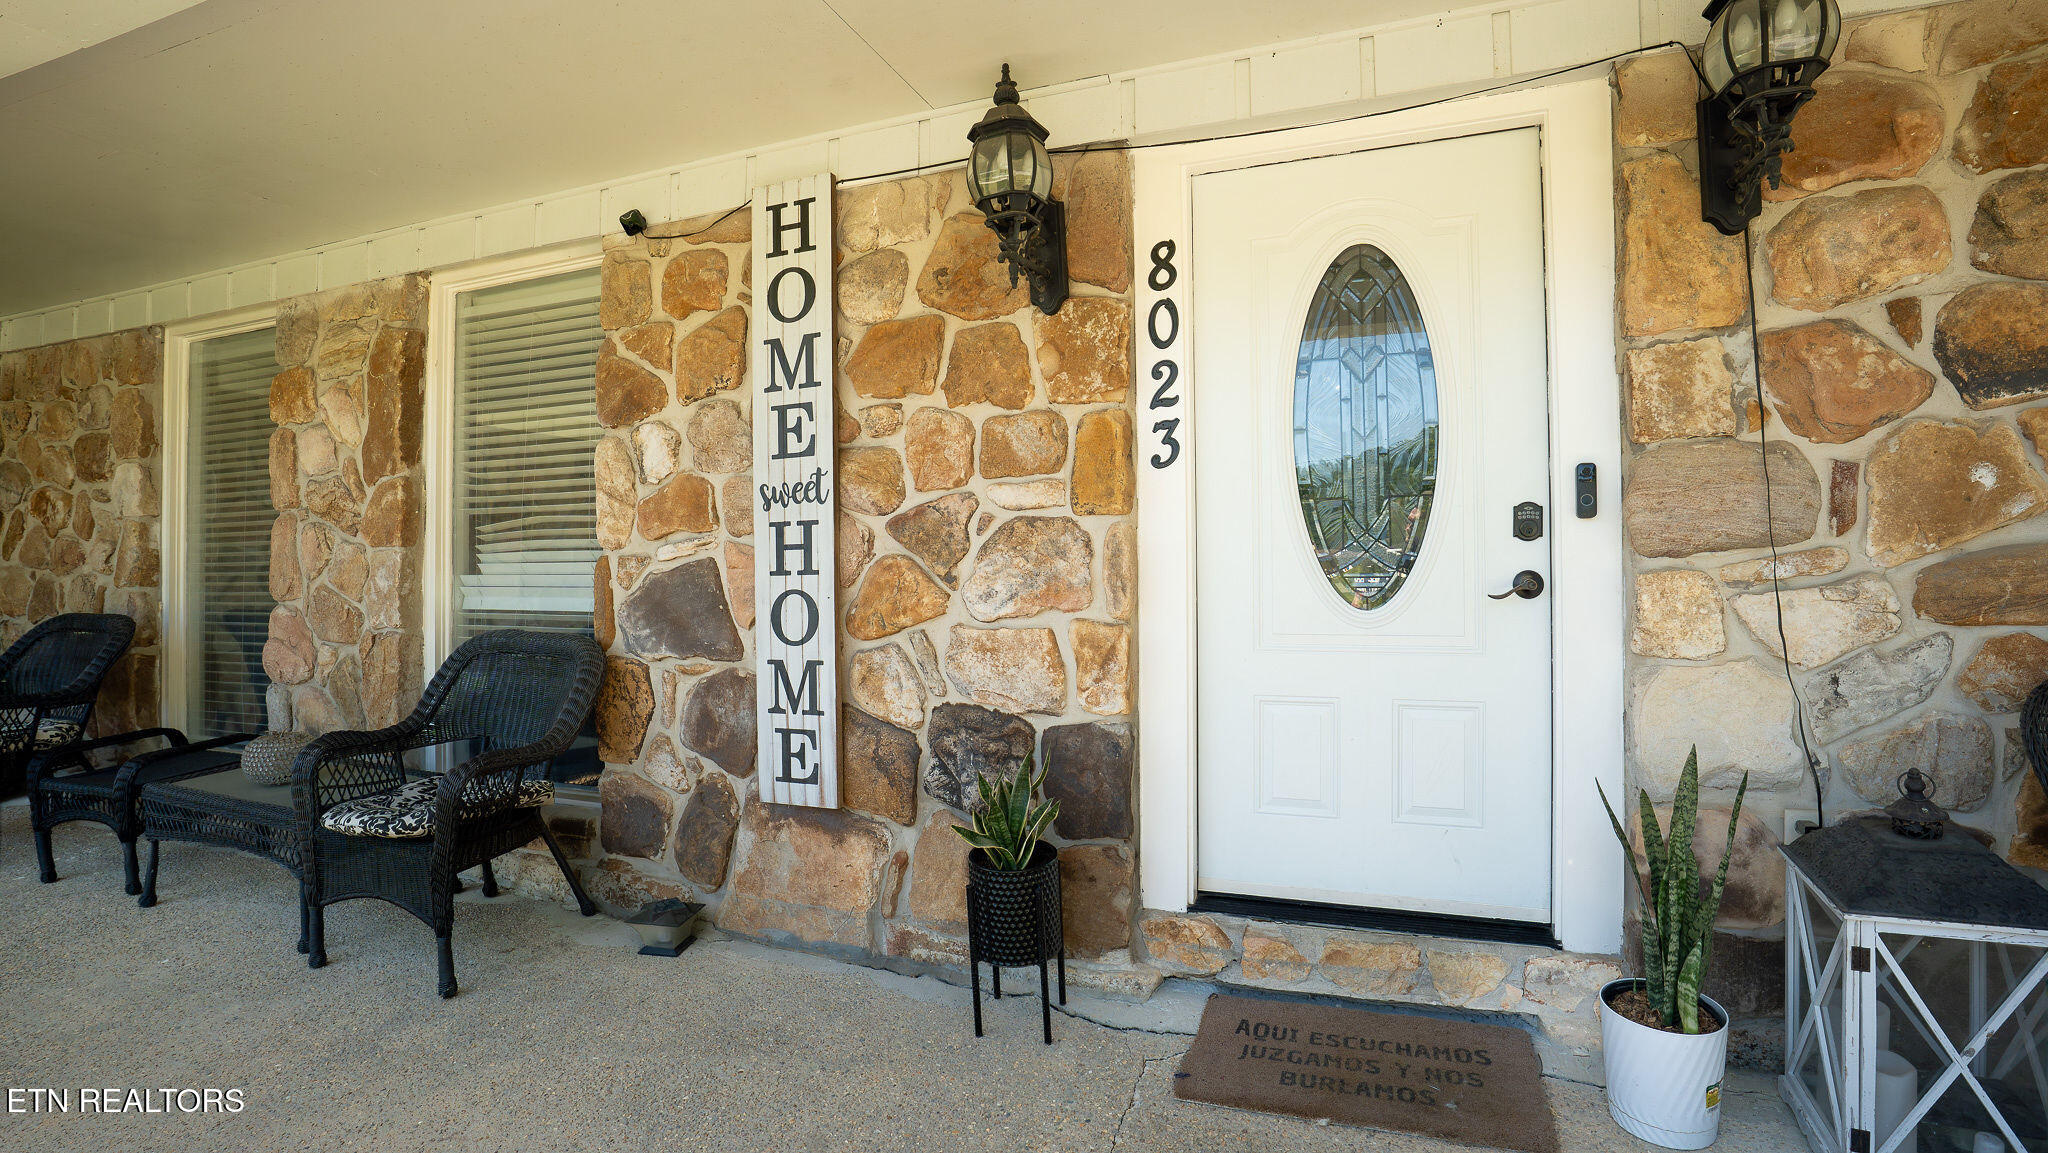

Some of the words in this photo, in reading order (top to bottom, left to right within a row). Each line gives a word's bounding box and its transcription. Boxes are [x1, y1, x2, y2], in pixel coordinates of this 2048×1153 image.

[763, 197, 822, 460] HOME
[1148, 239, 1181, 469] 8023
[759, 467, 829, 512] sweet
[767, 519, 825, 785] HOME
[1234, 1018, 1298, 1043] AQUI
[1309, 1032, 1492, 1066] ESCUCHAMOS
[1237, 1044, 1380, 1075] JUZGAMOS
[1395, 1061, 1411, 1079] Y
[1425, 1066, 1484, 1088] NOS
[1279, 1070, 1436, 1106] BURLAMOS
